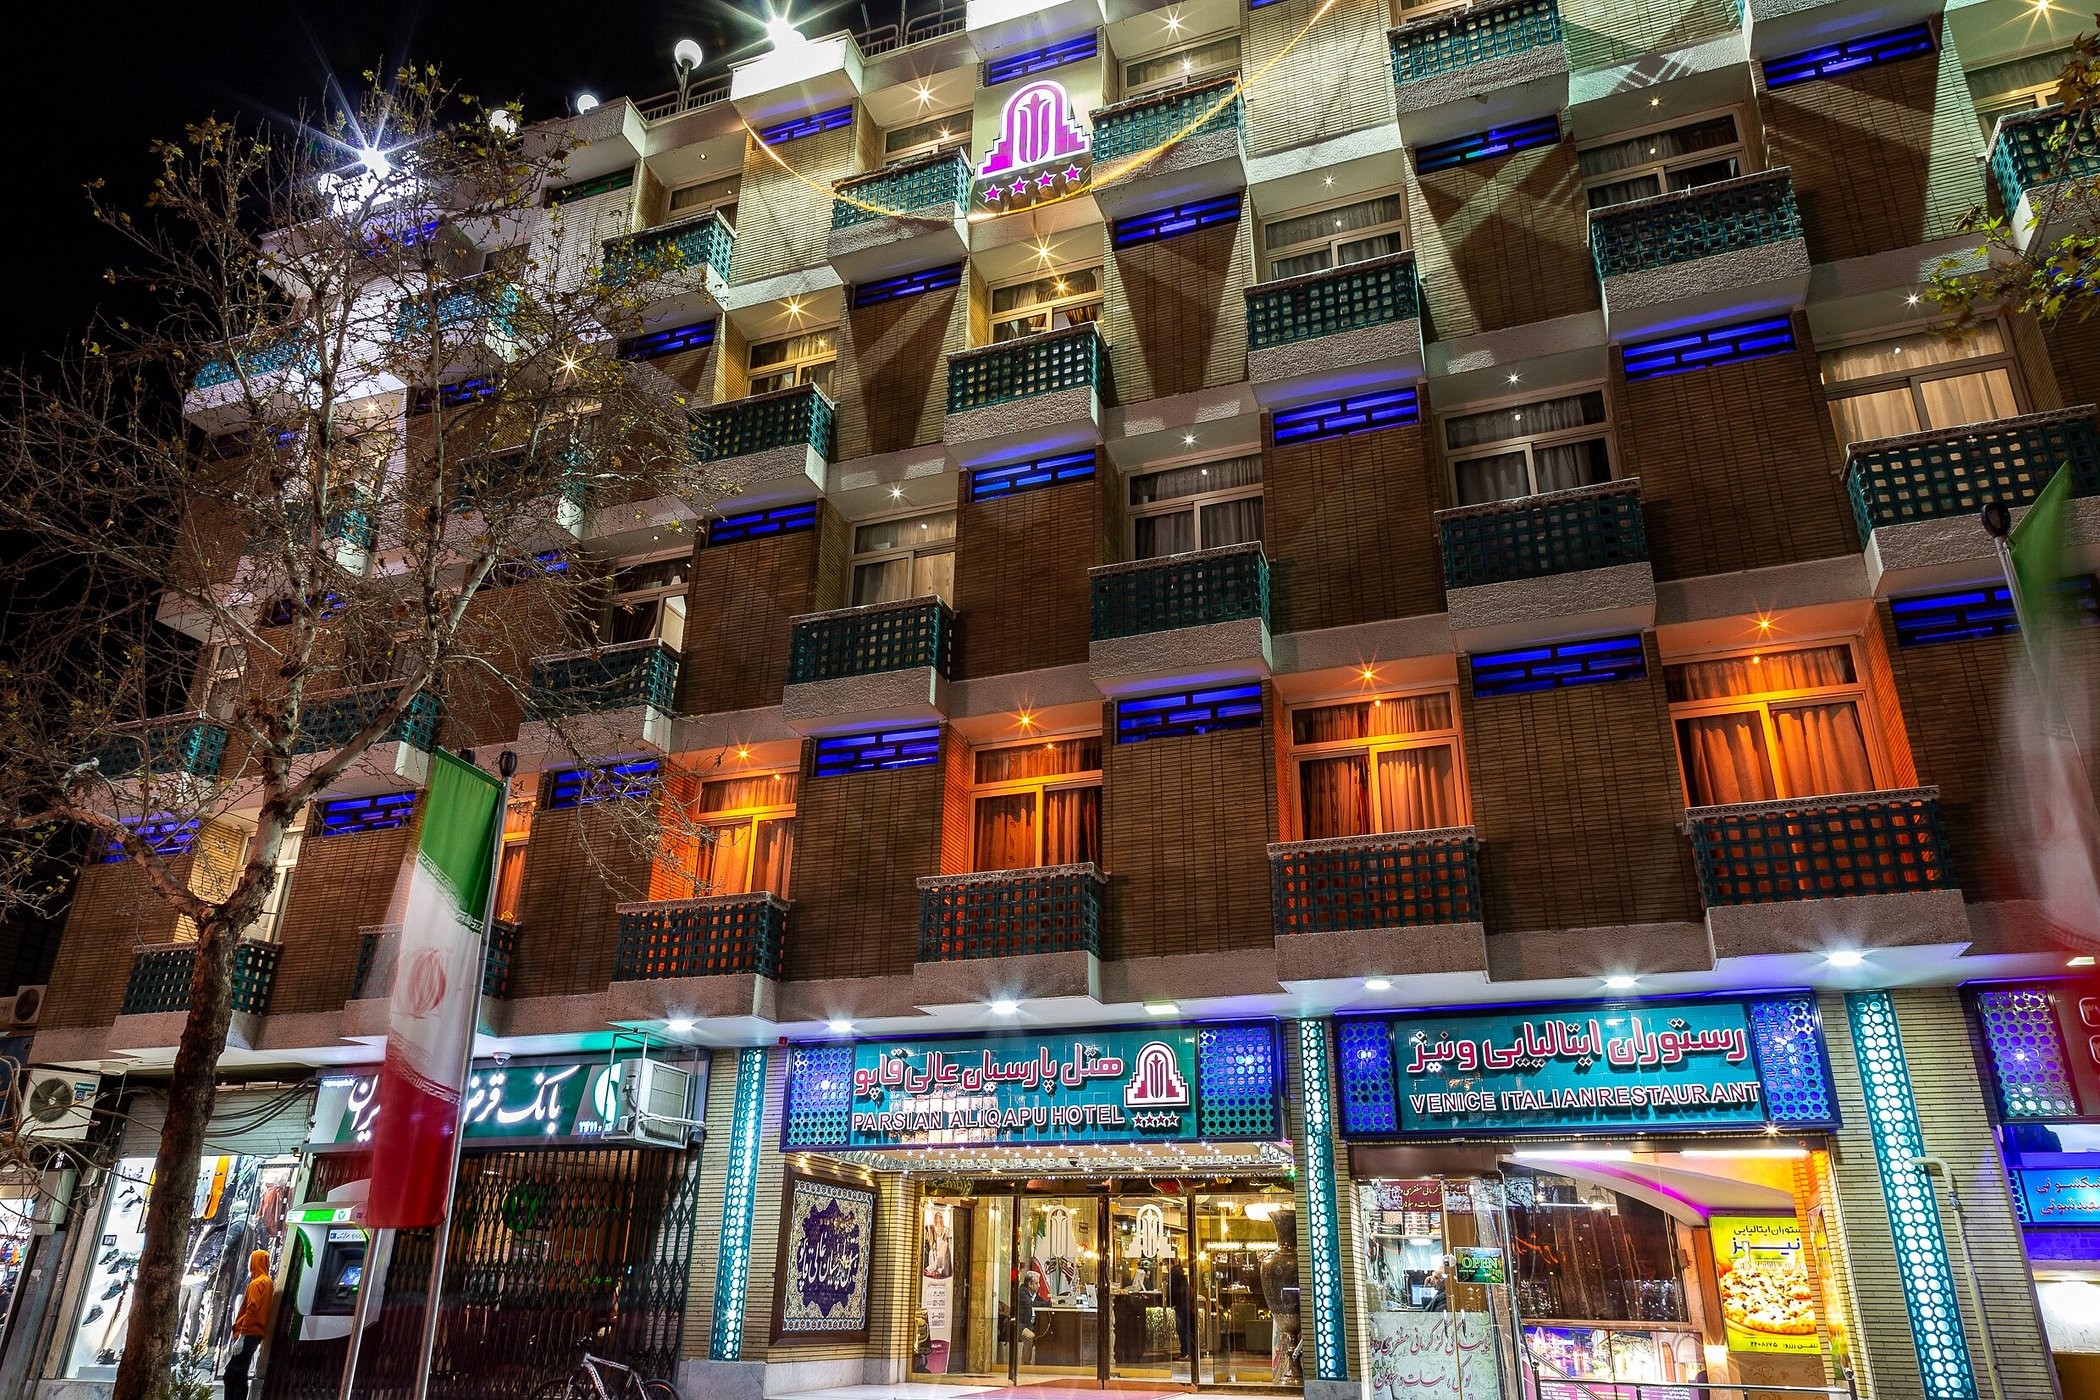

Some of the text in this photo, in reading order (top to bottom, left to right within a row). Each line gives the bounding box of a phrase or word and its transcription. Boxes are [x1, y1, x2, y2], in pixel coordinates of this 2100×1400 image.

[1406, 1017, 1748, 1073] رستوران ایتالیایی ونیز
[854, 1043, 1125, 1101] هتل پارسیان عالی قاپو
[497, 1064, 582, 1135] بانک
[1408, 1091, 1497, 1114] VENICE
[852, 1111, 945, 1131] PARSIAN
[1051, 1104, 1126, 1127] HOTEL
[1733, 1225, 1801, 1237] ستوران ایتالیایی
[1732, 1236, 1801, 1256] نیز
[1461, 1256, 1498, 1269] OPEN
